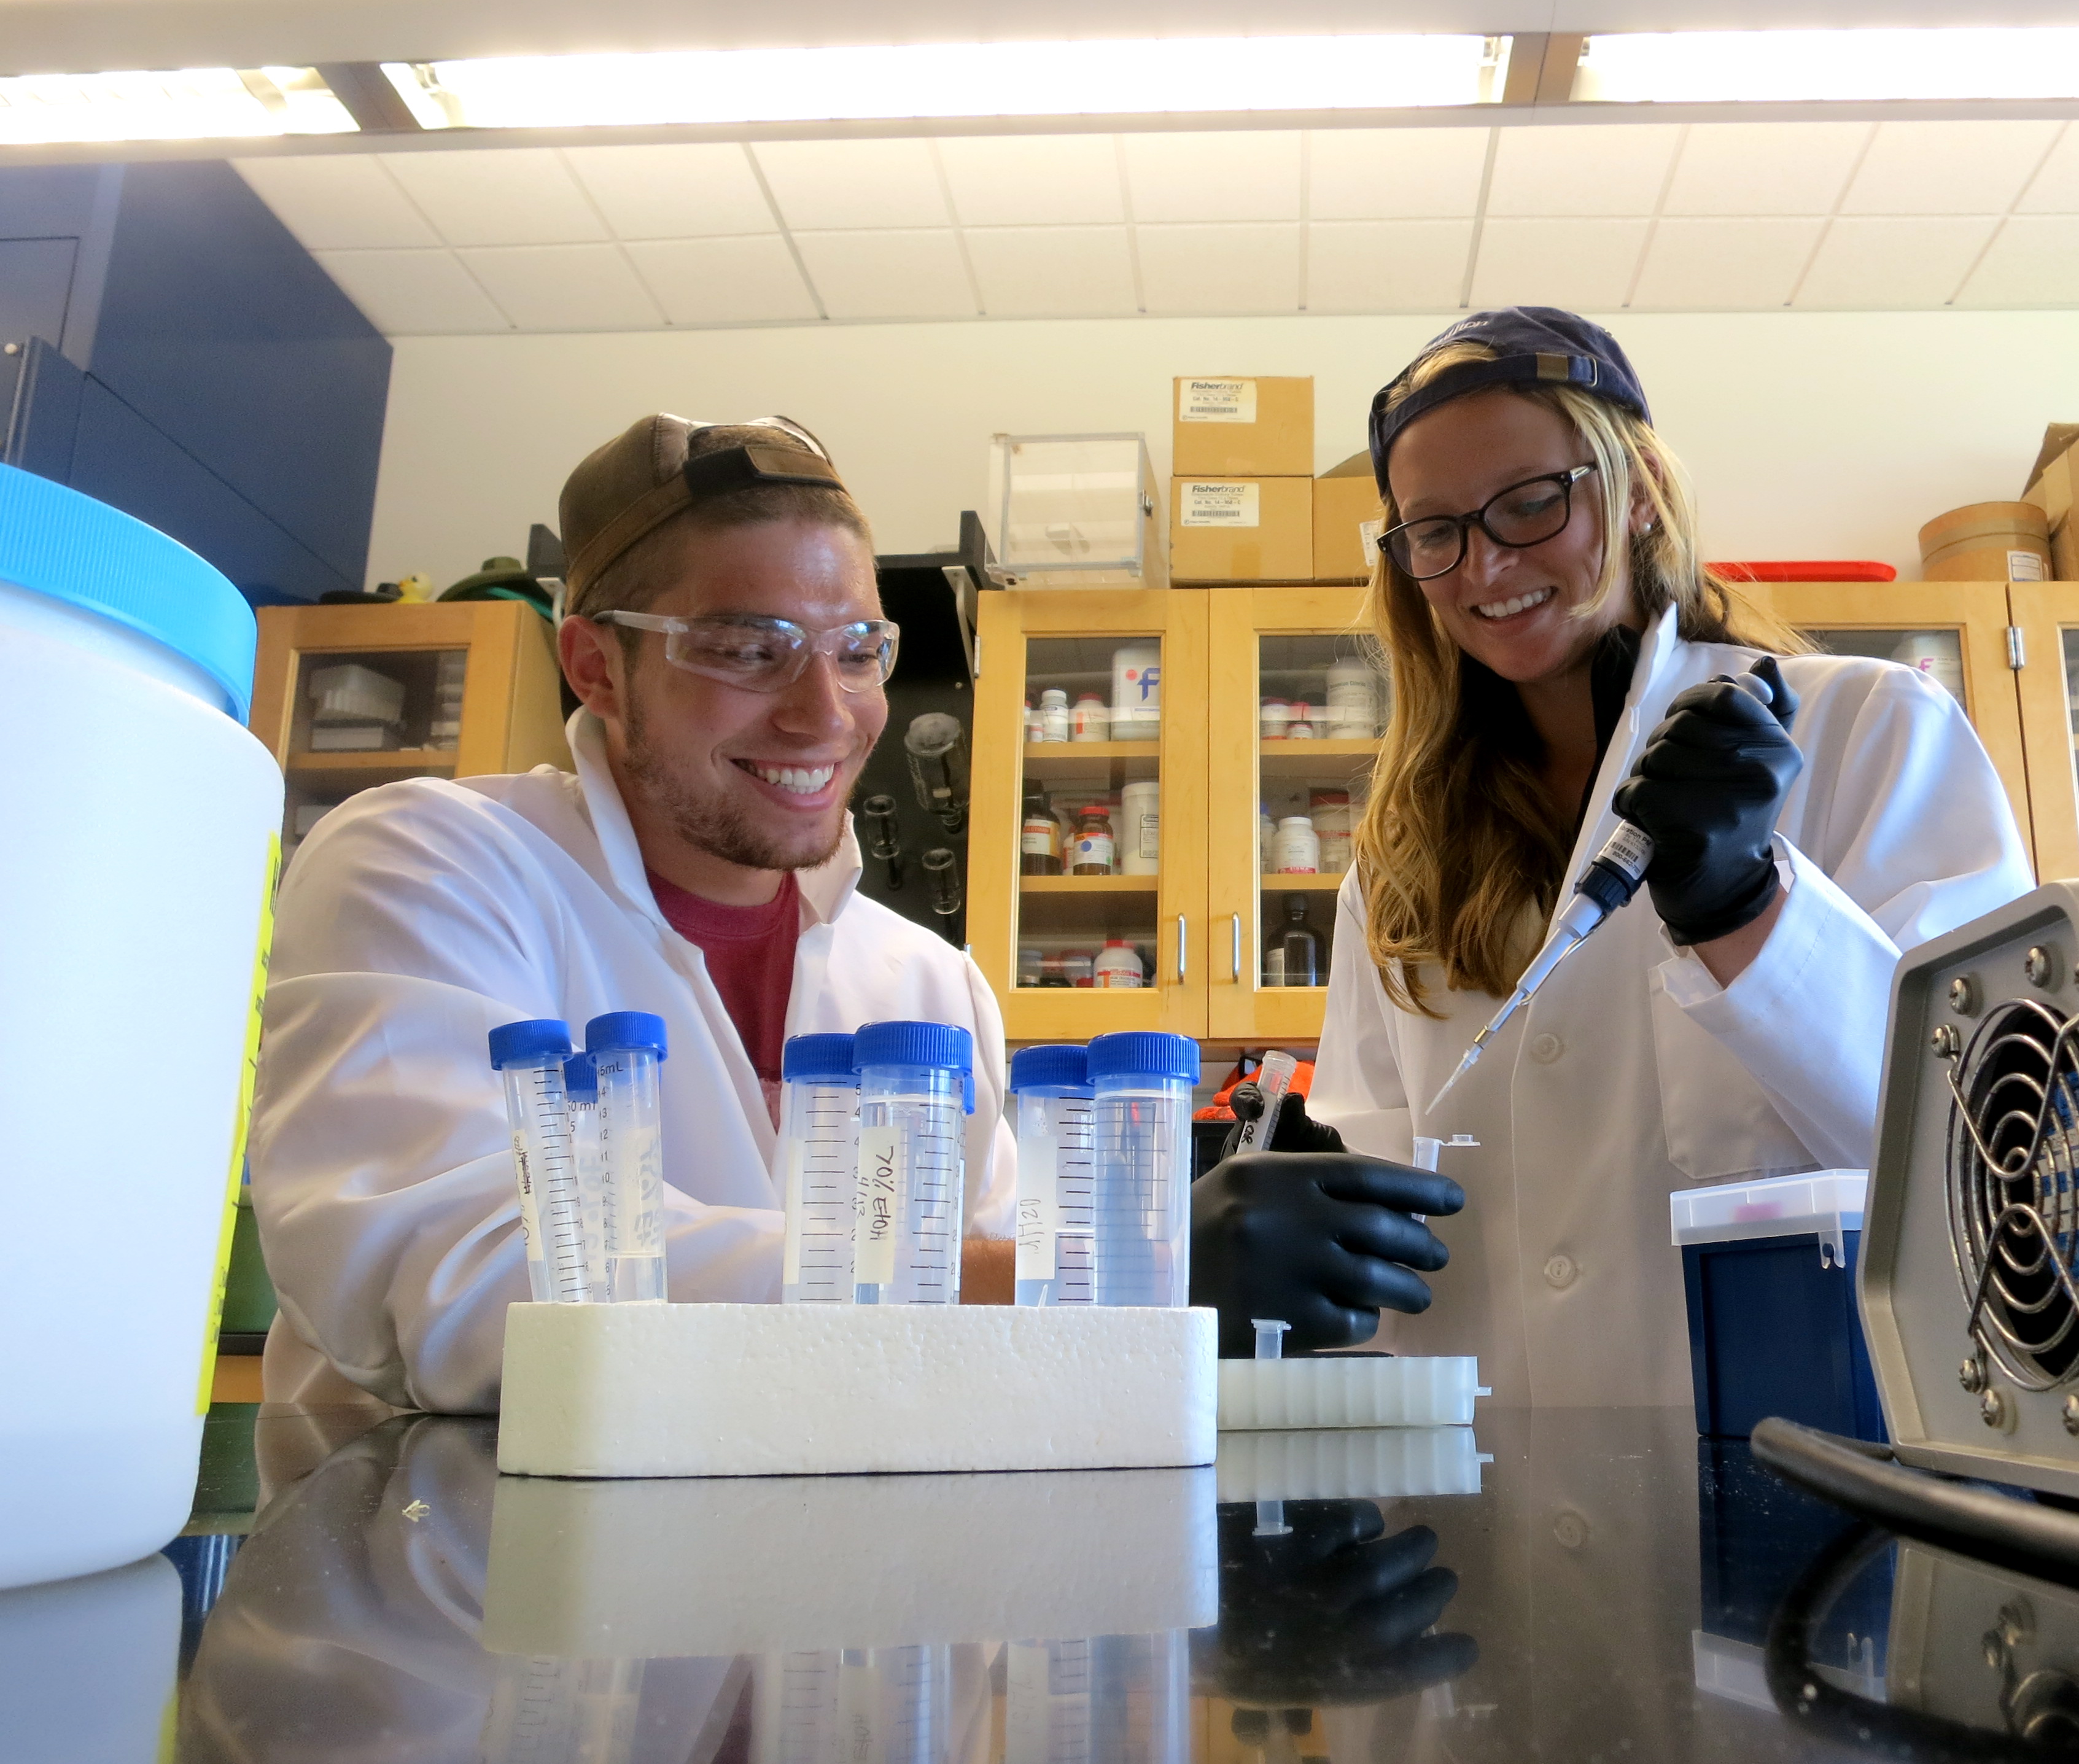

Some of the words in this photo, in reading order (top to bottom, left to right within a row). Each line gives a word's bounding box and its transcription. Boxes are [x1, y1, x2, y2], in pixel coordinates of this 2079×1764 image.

[600, 1129, 608, 1141] 12
[601, 1151, 608, 1162] 11
[872, 1146, 895, 1192] 70%
[602, 1172, 610, 1184] 10
[605, 1262, 610, 1273] 6
